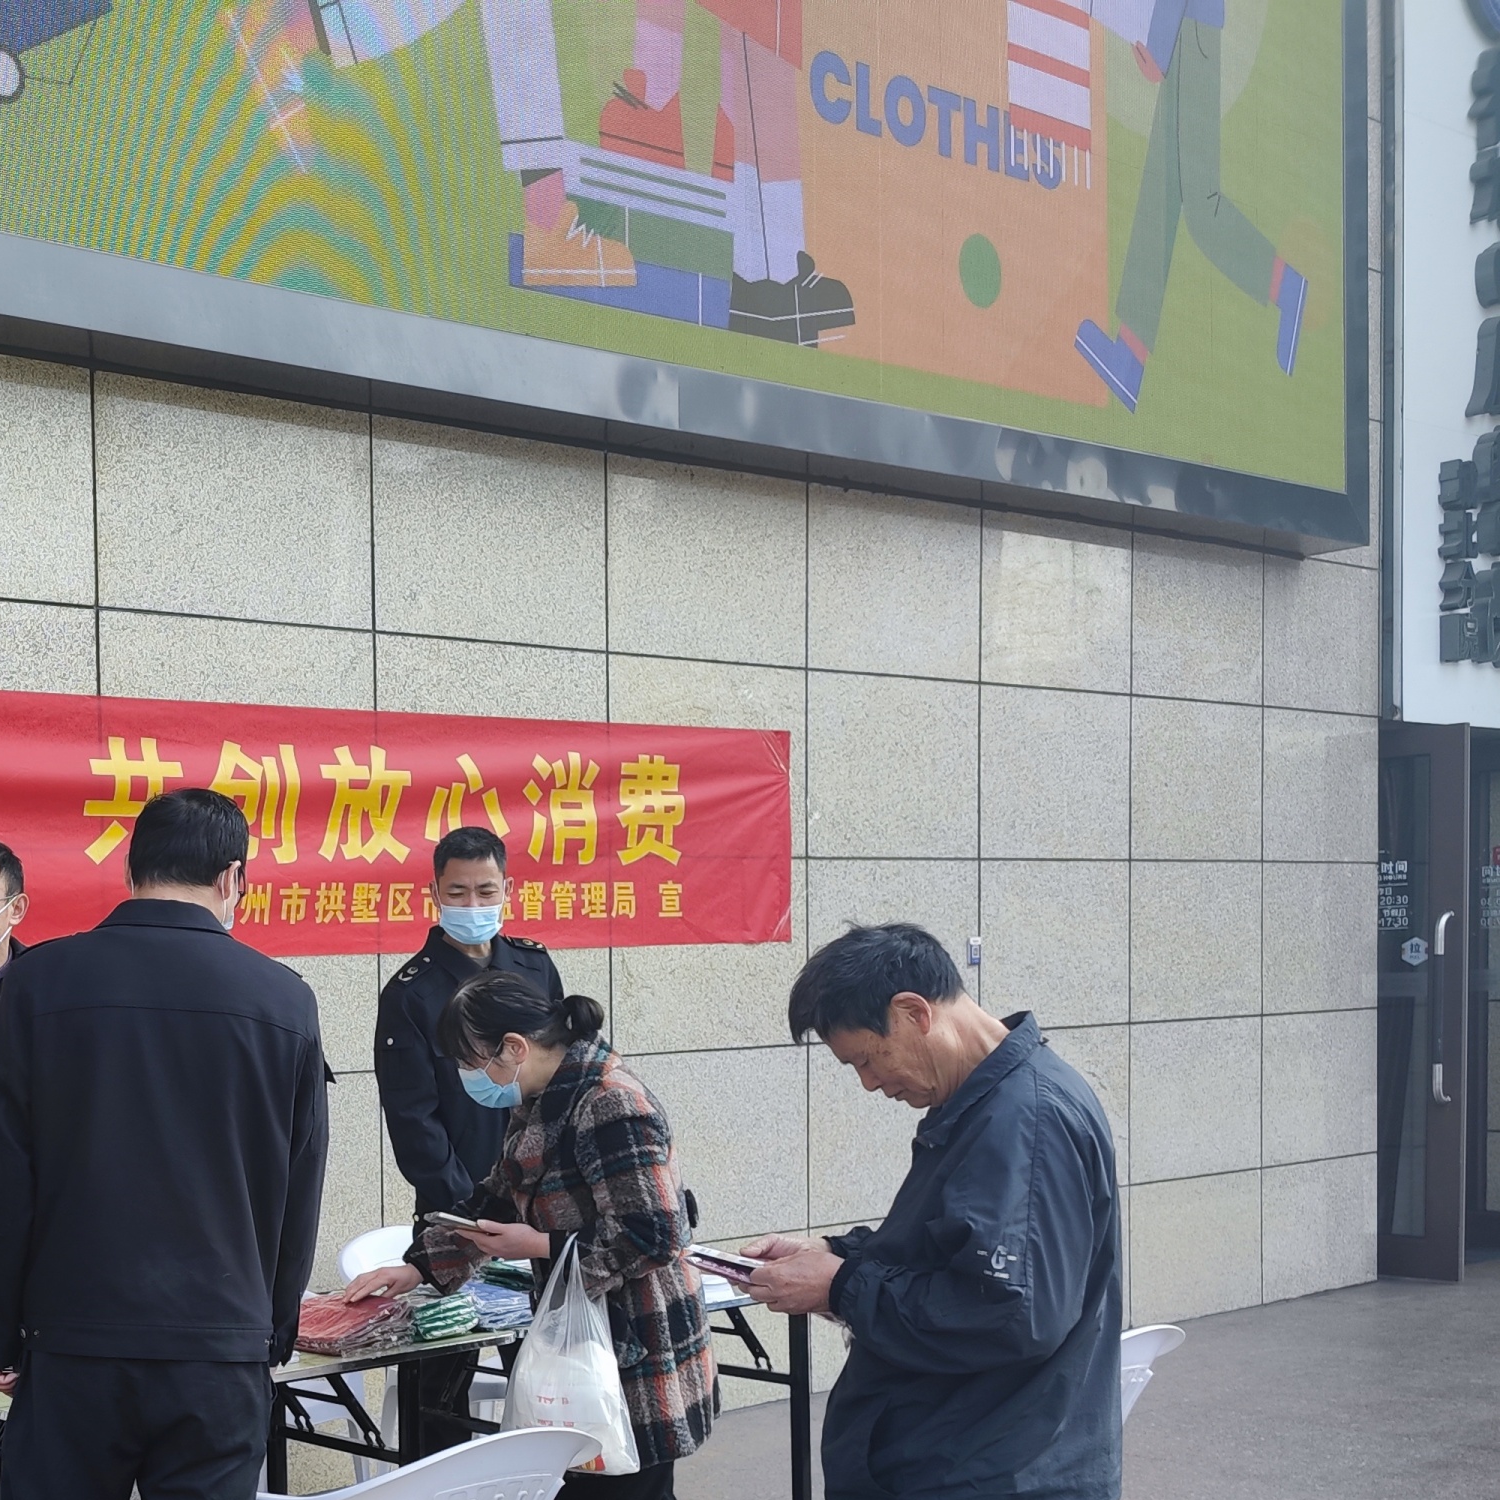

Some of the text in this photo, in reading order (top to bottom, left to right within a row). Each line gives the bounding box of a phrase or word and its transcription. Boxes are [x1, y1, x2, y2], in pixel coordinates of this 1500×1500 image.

[810, 51, 1062, 190] CLOTHES
[83, 736, 687, 866] 共创放心消费
[240, 880, 684, 926] 州市拱墅区市督管理局 宣
[1378, 860, 1408, 875] 时间
